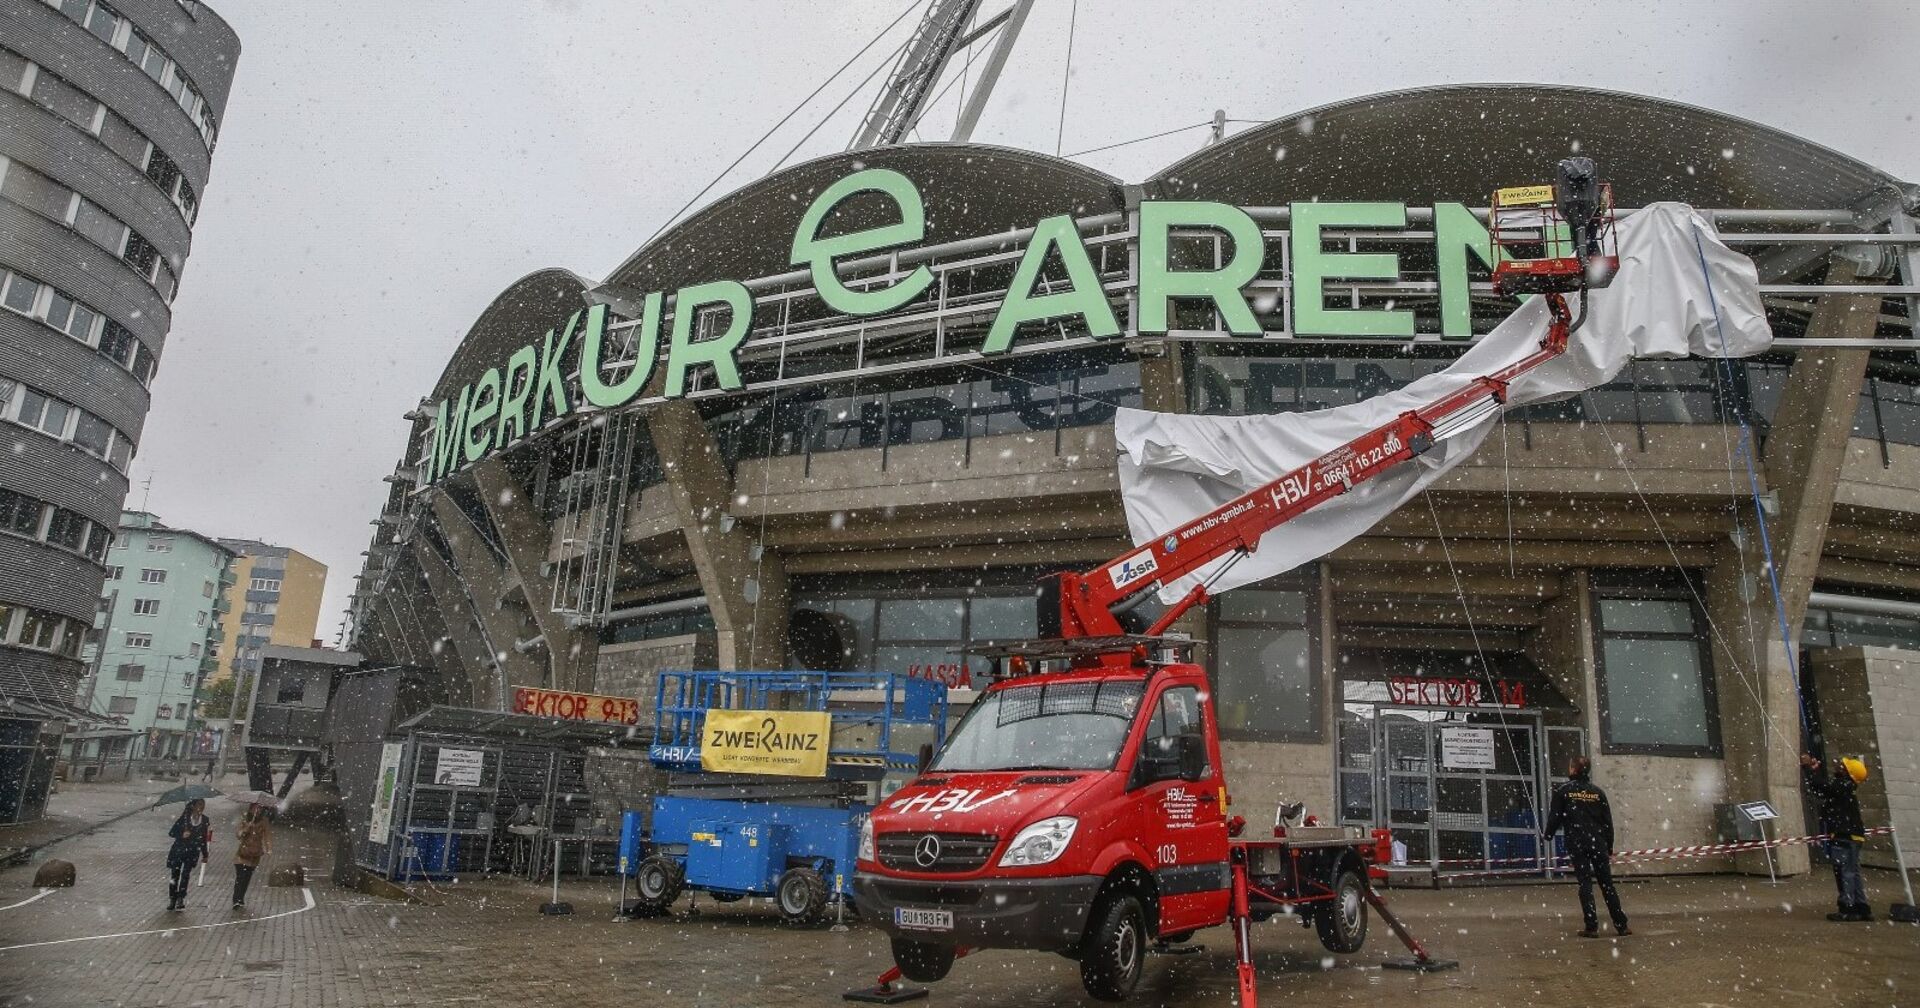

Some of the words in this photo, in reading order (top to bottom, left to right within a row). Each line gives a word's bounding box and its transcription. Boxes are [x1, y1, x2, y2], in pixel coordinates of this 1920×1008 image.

[1323, 464, 1350, 487] 0664
[1356, 454, 1370, 470] 16
[1369, 447, 1384, 464] 22
[1383, 437, 1402, 456] 600
[1180, 499, 1256, 540] www.hbv-gmbh.at
[1129, 559, 1155, 579] GSR
[908, 663, 972, 689] KASSA
[513, 687, 588, 721] SEKTOR
[601, 698, 639, 725] 9-13
[1391, 677, 1480, 708] SEKTOR
[1497, 679, 1526, 710] 14
[739, 826, 757, 838] 448
[1156, 844, 1177, 864] 103
[902, 910, 913, 924] GU
[919, 912, 934, 925] 183
